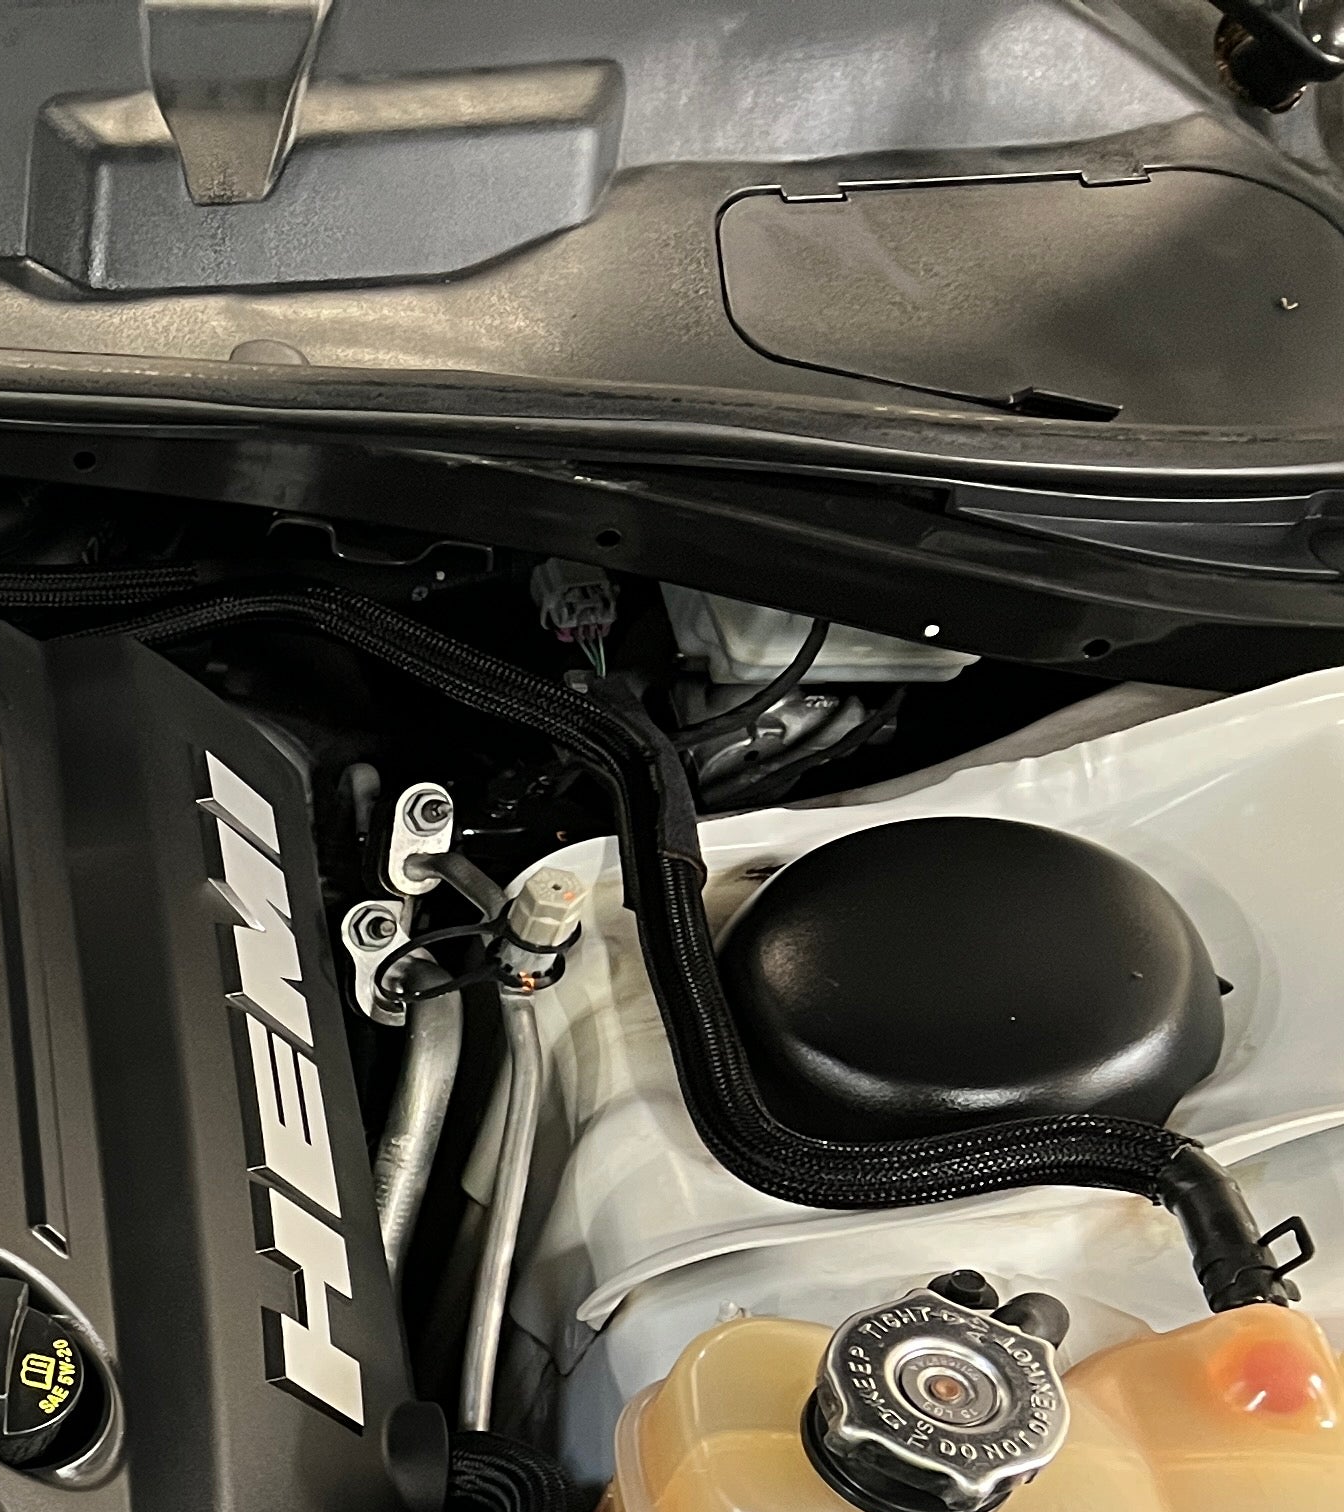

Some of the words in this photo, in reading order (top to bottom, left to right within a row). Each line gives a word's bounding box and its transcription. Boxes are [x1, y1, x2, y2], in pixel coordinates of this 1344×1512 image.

[200, 750, 365, 1428] HEMI
[858, 1306, 931, 1340] TIGHT
[1001, 1336, 1046, 1380] HOT
[848, 1345, 886, 1406] KEEP
[38, 1385, 69, 1415] SAE
[1027, 1377, 1056, 1437] OPEN
[906, 1419, 935, 1449] TVS
[939, 1438, 978, 1460] DO
[982, 1430, 1036, 1460] NOT
